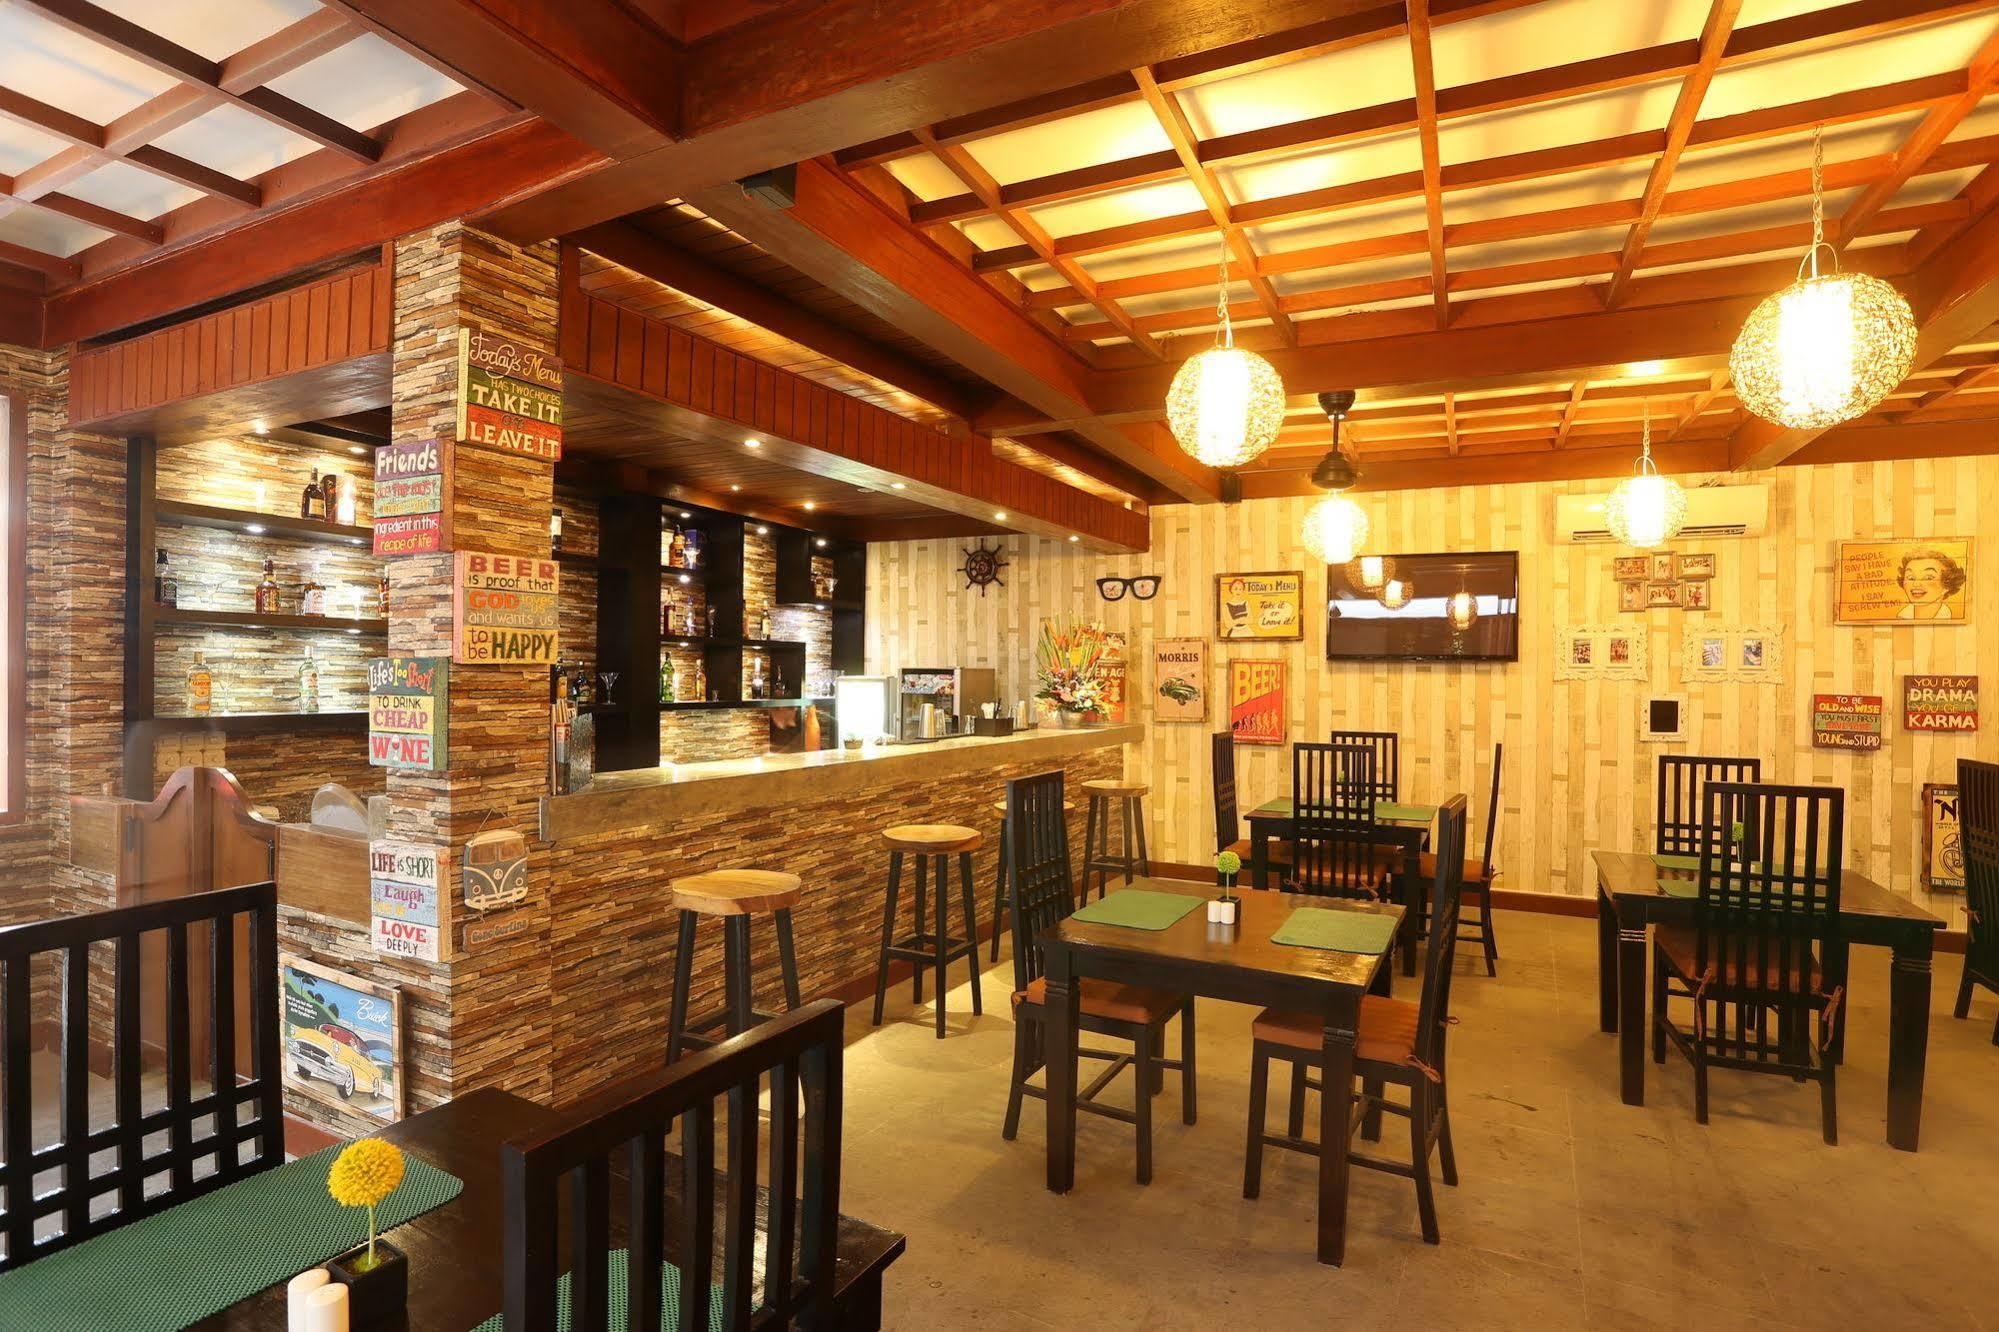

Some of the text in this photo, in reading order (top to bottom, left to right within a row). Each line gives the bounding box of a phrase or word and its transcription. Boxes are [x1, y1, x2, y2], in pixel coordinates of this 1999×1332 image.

[470, 332, 562, 384] Today's Menu
[491, 379, 560, 406] HAS TWO CHOICES
[472, 383, 560, 424] TAKE IT
[470, 421, 559, 458] LEAVE IT
[377, 443, 438, 476] Friends
[421, 516, 438, 530] this
[380, 533, 432, 553] recipe of life
[470, 554, 555, 580] BEER
[486, 576, 520, 588] proof
[527, 578, 553, 591] that
[469, 591, 520, 609] GOD
[468, 611, 492, 624] and
[496, 612, 533, 625] wants
[468, 627, 488, 644] to
[468, 643, 488, 659] be
[491, 631, 555, 660] HAPPY
[1158, 653, 1199, 662] MORRIS
[369, 660, 394, 692] Life's
[393, 659, 407, 686] Too
[1914, 678, 1971, 687] YOU PLAY
[377, 695, 421, 709] TO DRINK
[1836, 696, 1848, 704] TO
[1910, 688, 1976, 702] DRAMA
[1819, 703, 1839, 712] OLD
[1854, 704, 1880, 714] WISE
[1915, 703, 1939, 713] YOU
[373, 707, 428, 730] CHEAP
[1908, 714, 1976, 728] KARMA
[1817, 732, 1844, 745] YOUNG
[1854, 734, 1880, 746] STUPID
[372, 852, 395, 873] LIFE
[406, 856, 434, 879] SHORT
[384, 885, 425, 910] Laugh
[381, 920, 427, 943] LOVE
[386, 938, 418, 955] DEEPLY
[356, 998, 390, 1027] Buick
